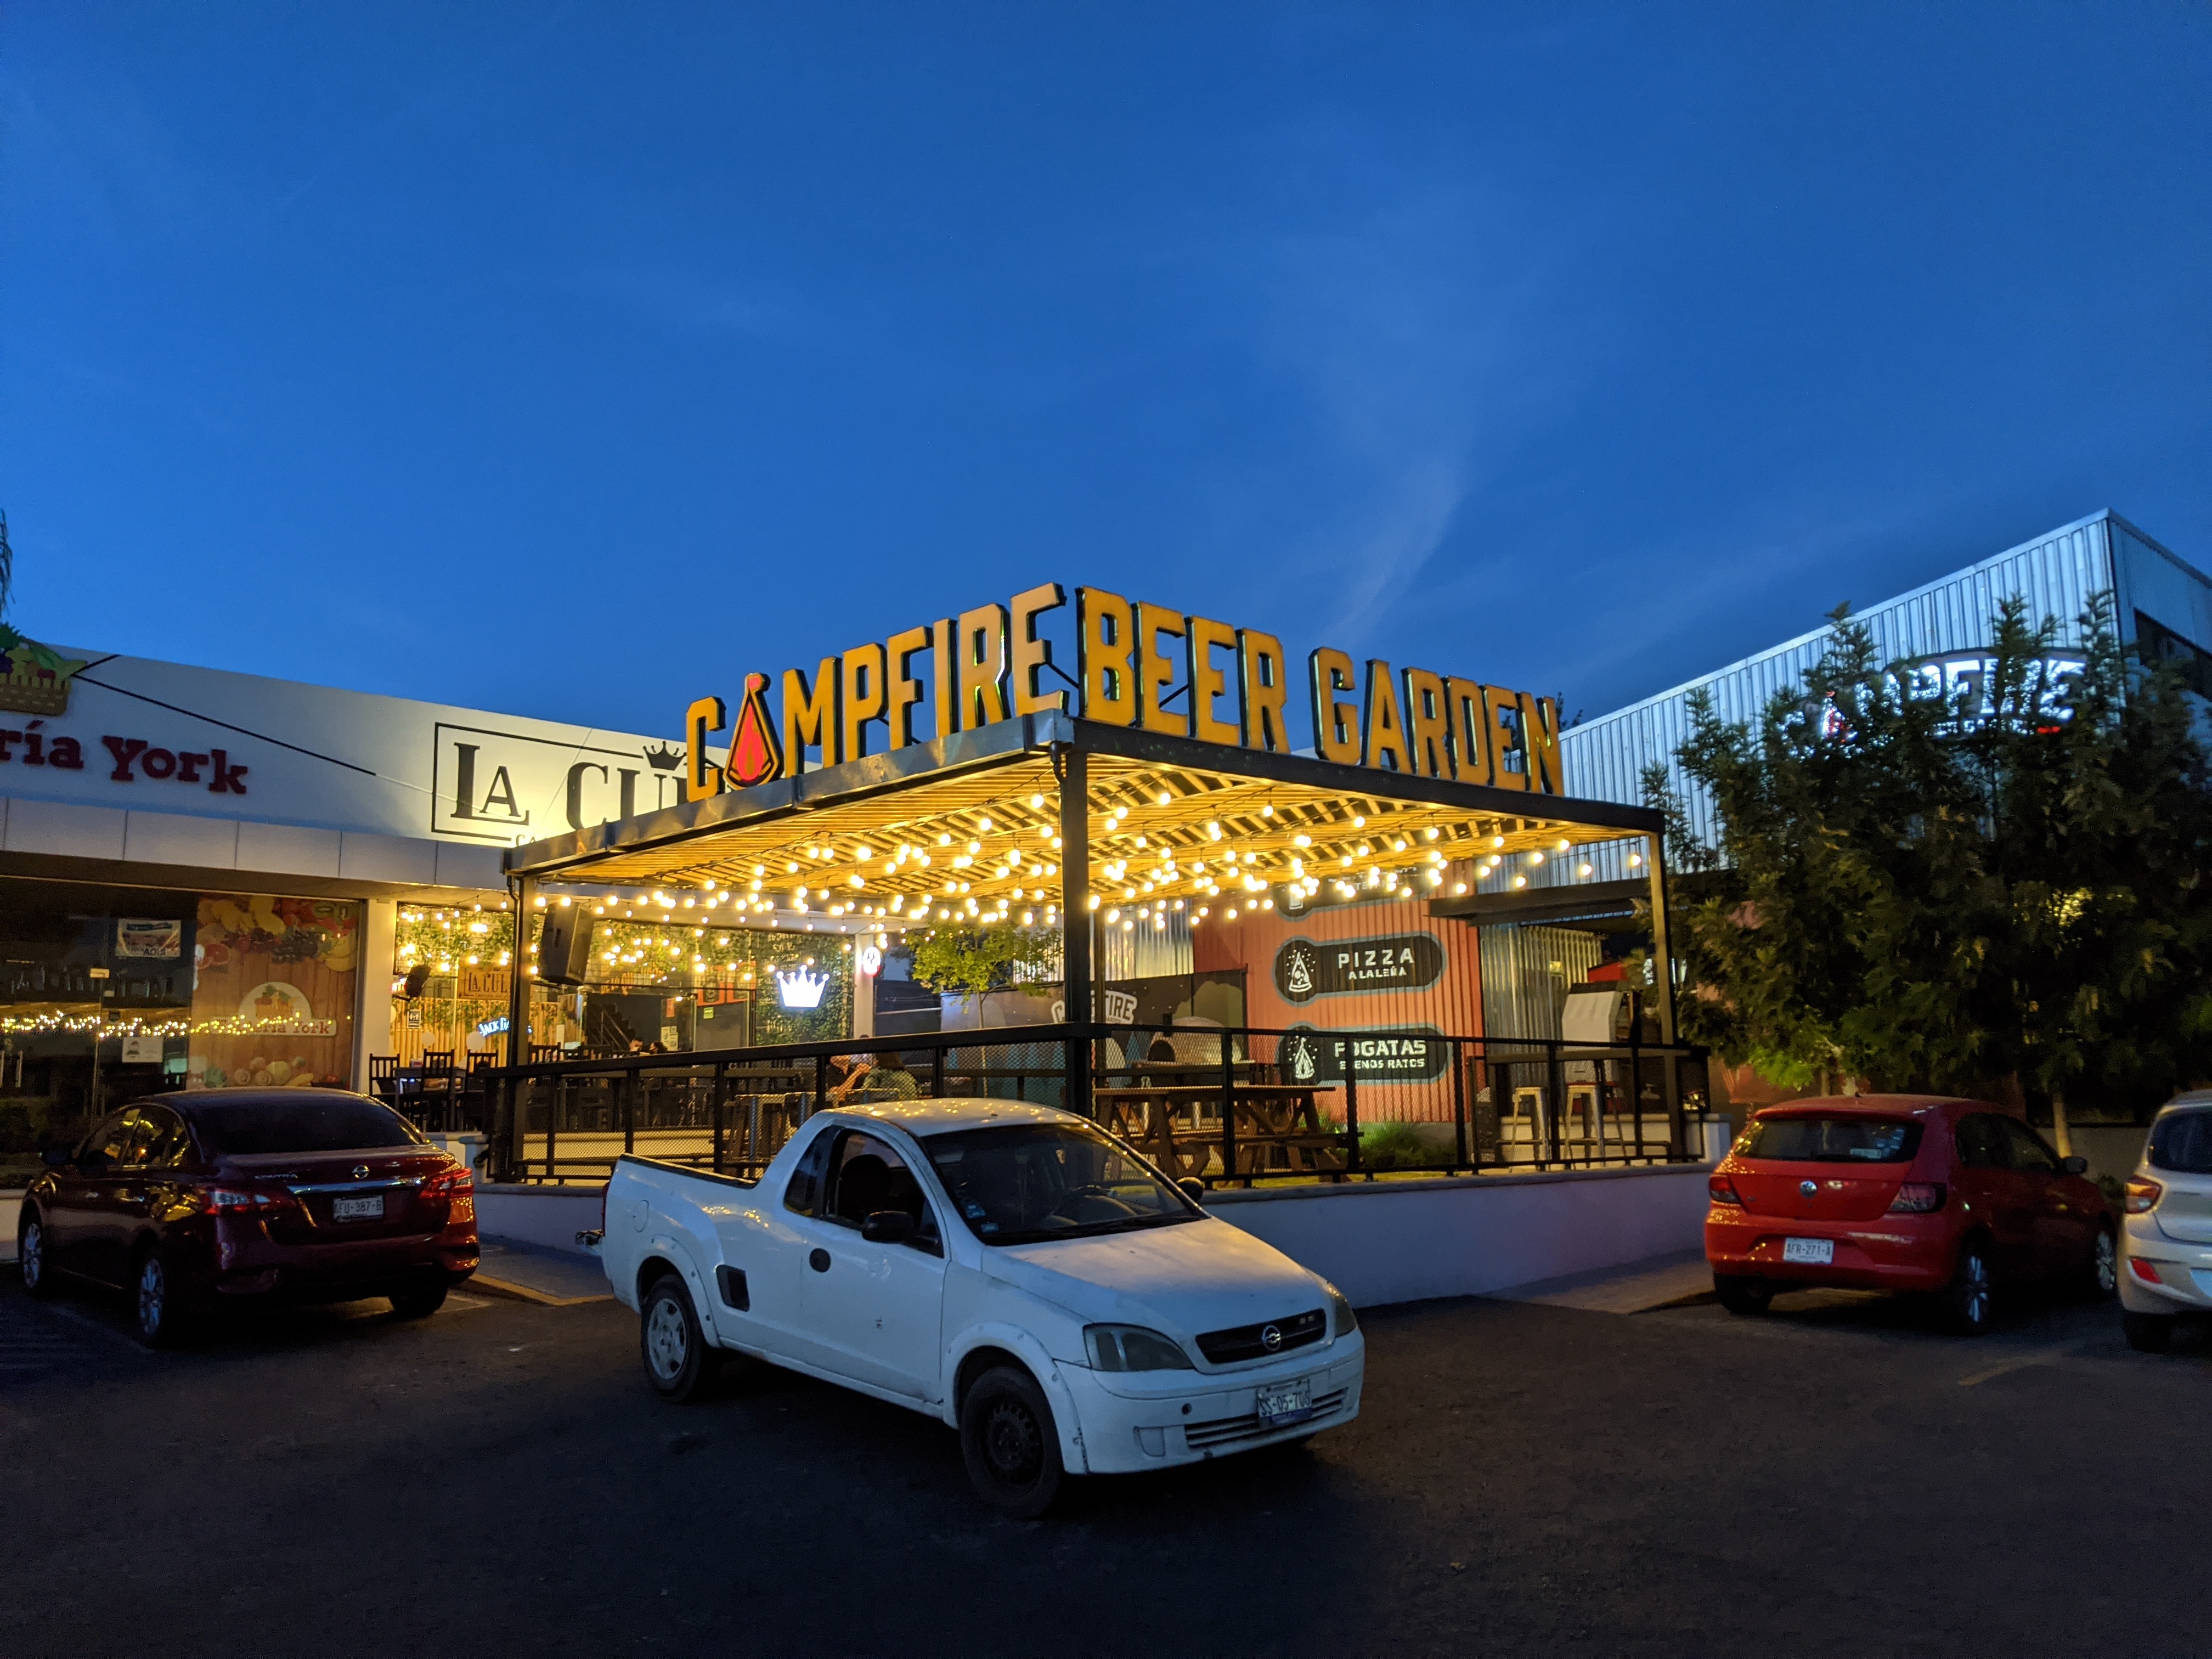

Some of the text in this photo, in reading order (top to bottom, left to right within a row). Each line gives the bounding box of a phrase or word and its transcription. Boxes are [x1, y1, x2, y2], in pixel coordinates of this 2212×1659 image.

[1075, 585, 1565, 795] BEER GARDEN
[102, 735, 249, 794] York
[1338, 947, 1415, 969] PIZZA
[1339, 1058, 1426, 1070] BENOS RATOS
